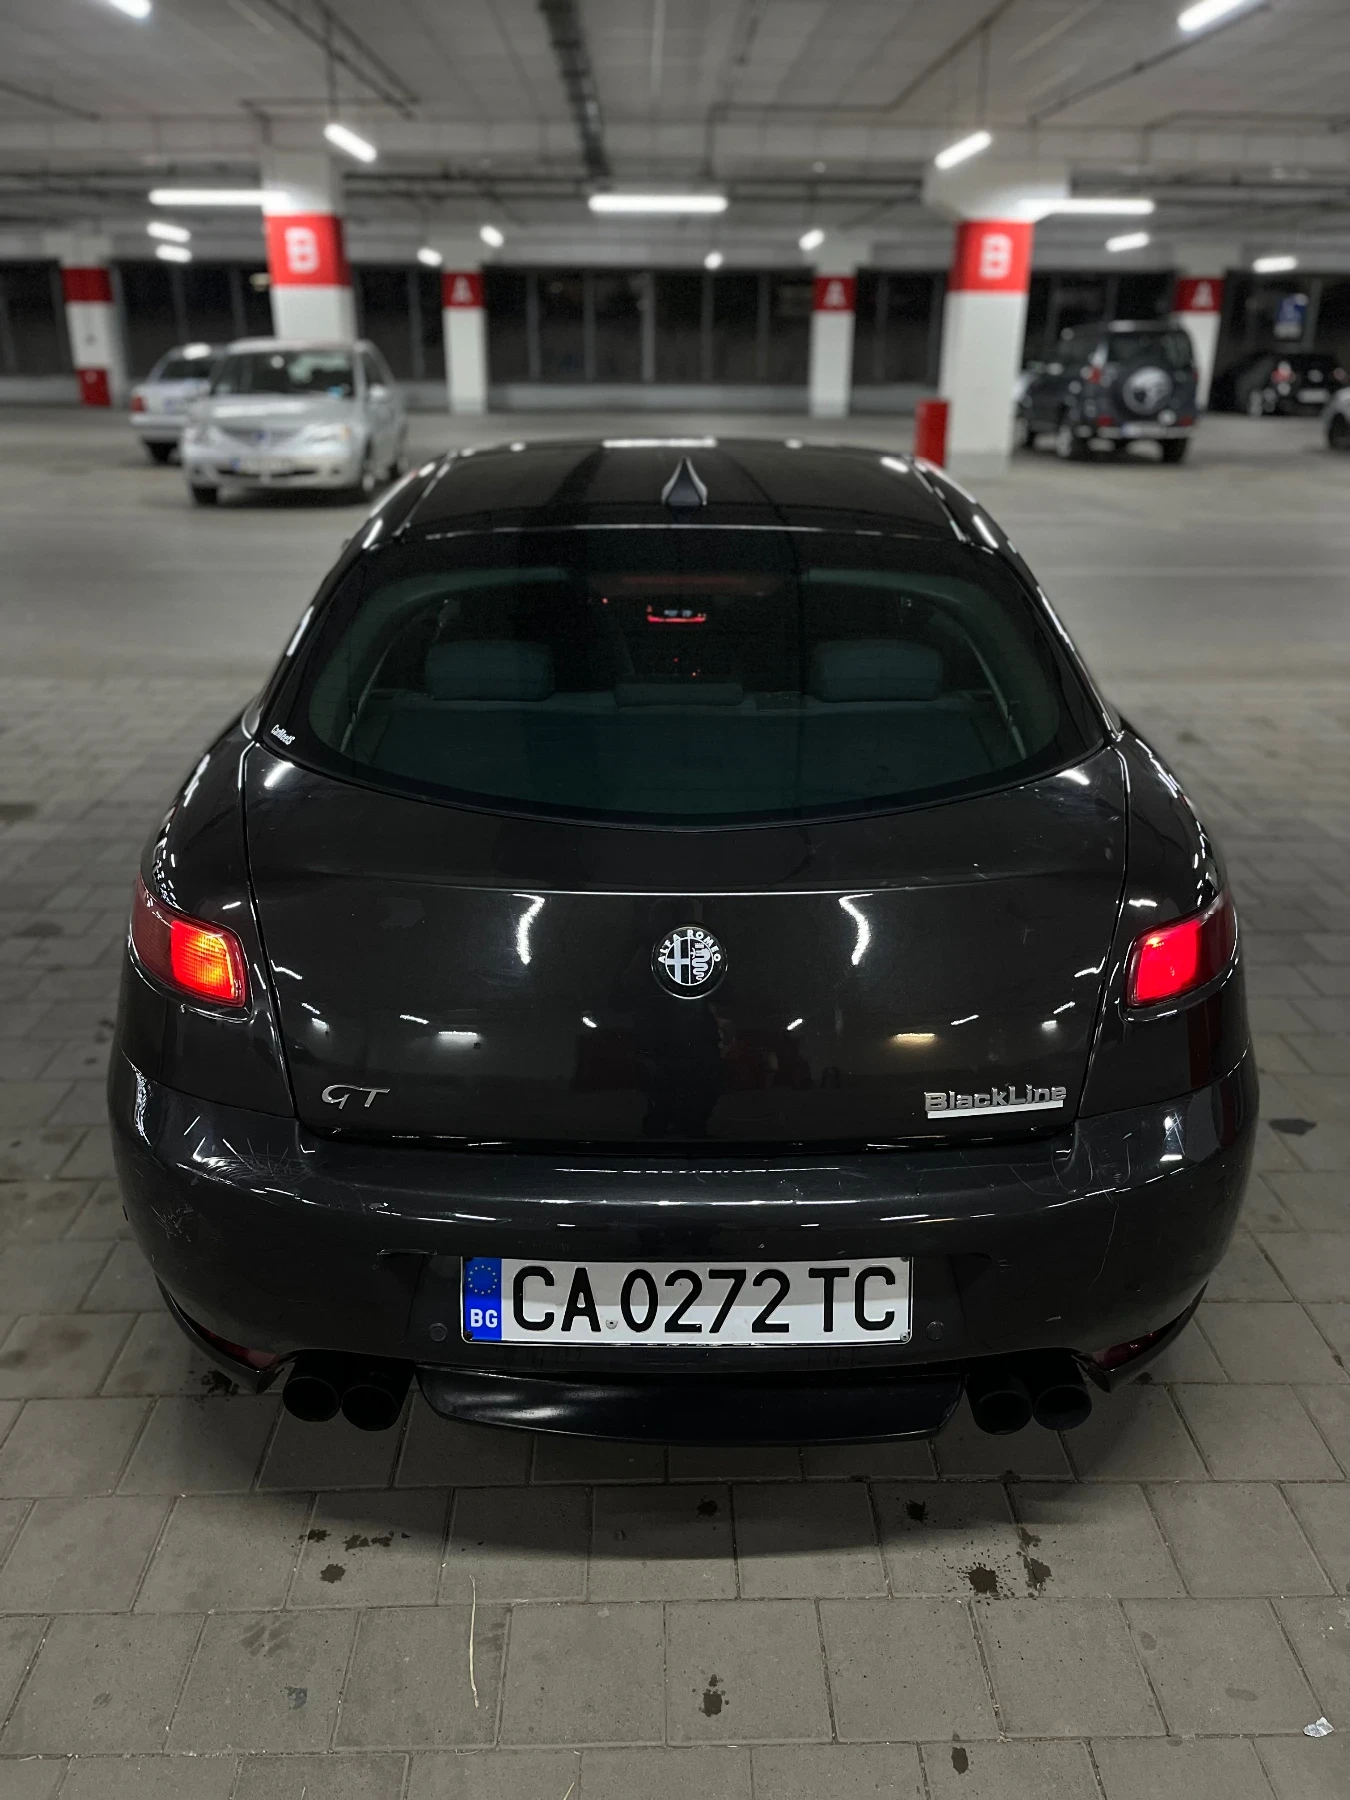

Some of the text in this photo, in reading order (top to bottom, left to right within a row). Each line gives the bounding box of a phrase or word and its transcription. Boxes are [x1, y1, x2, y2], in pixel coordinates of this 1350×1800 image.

[284, 228, 319, 274] B
[979, 232, 1013, 279] B
[657, 929, 722, 964] ALFA ROMEO
[321, 1084, 391, 1110] GT
[924, 1083, 1067, 1111] BlackLine
[512, 1265, 896, 1333] CA 0272 TC
[470, 1308, 498, 1328] BG
